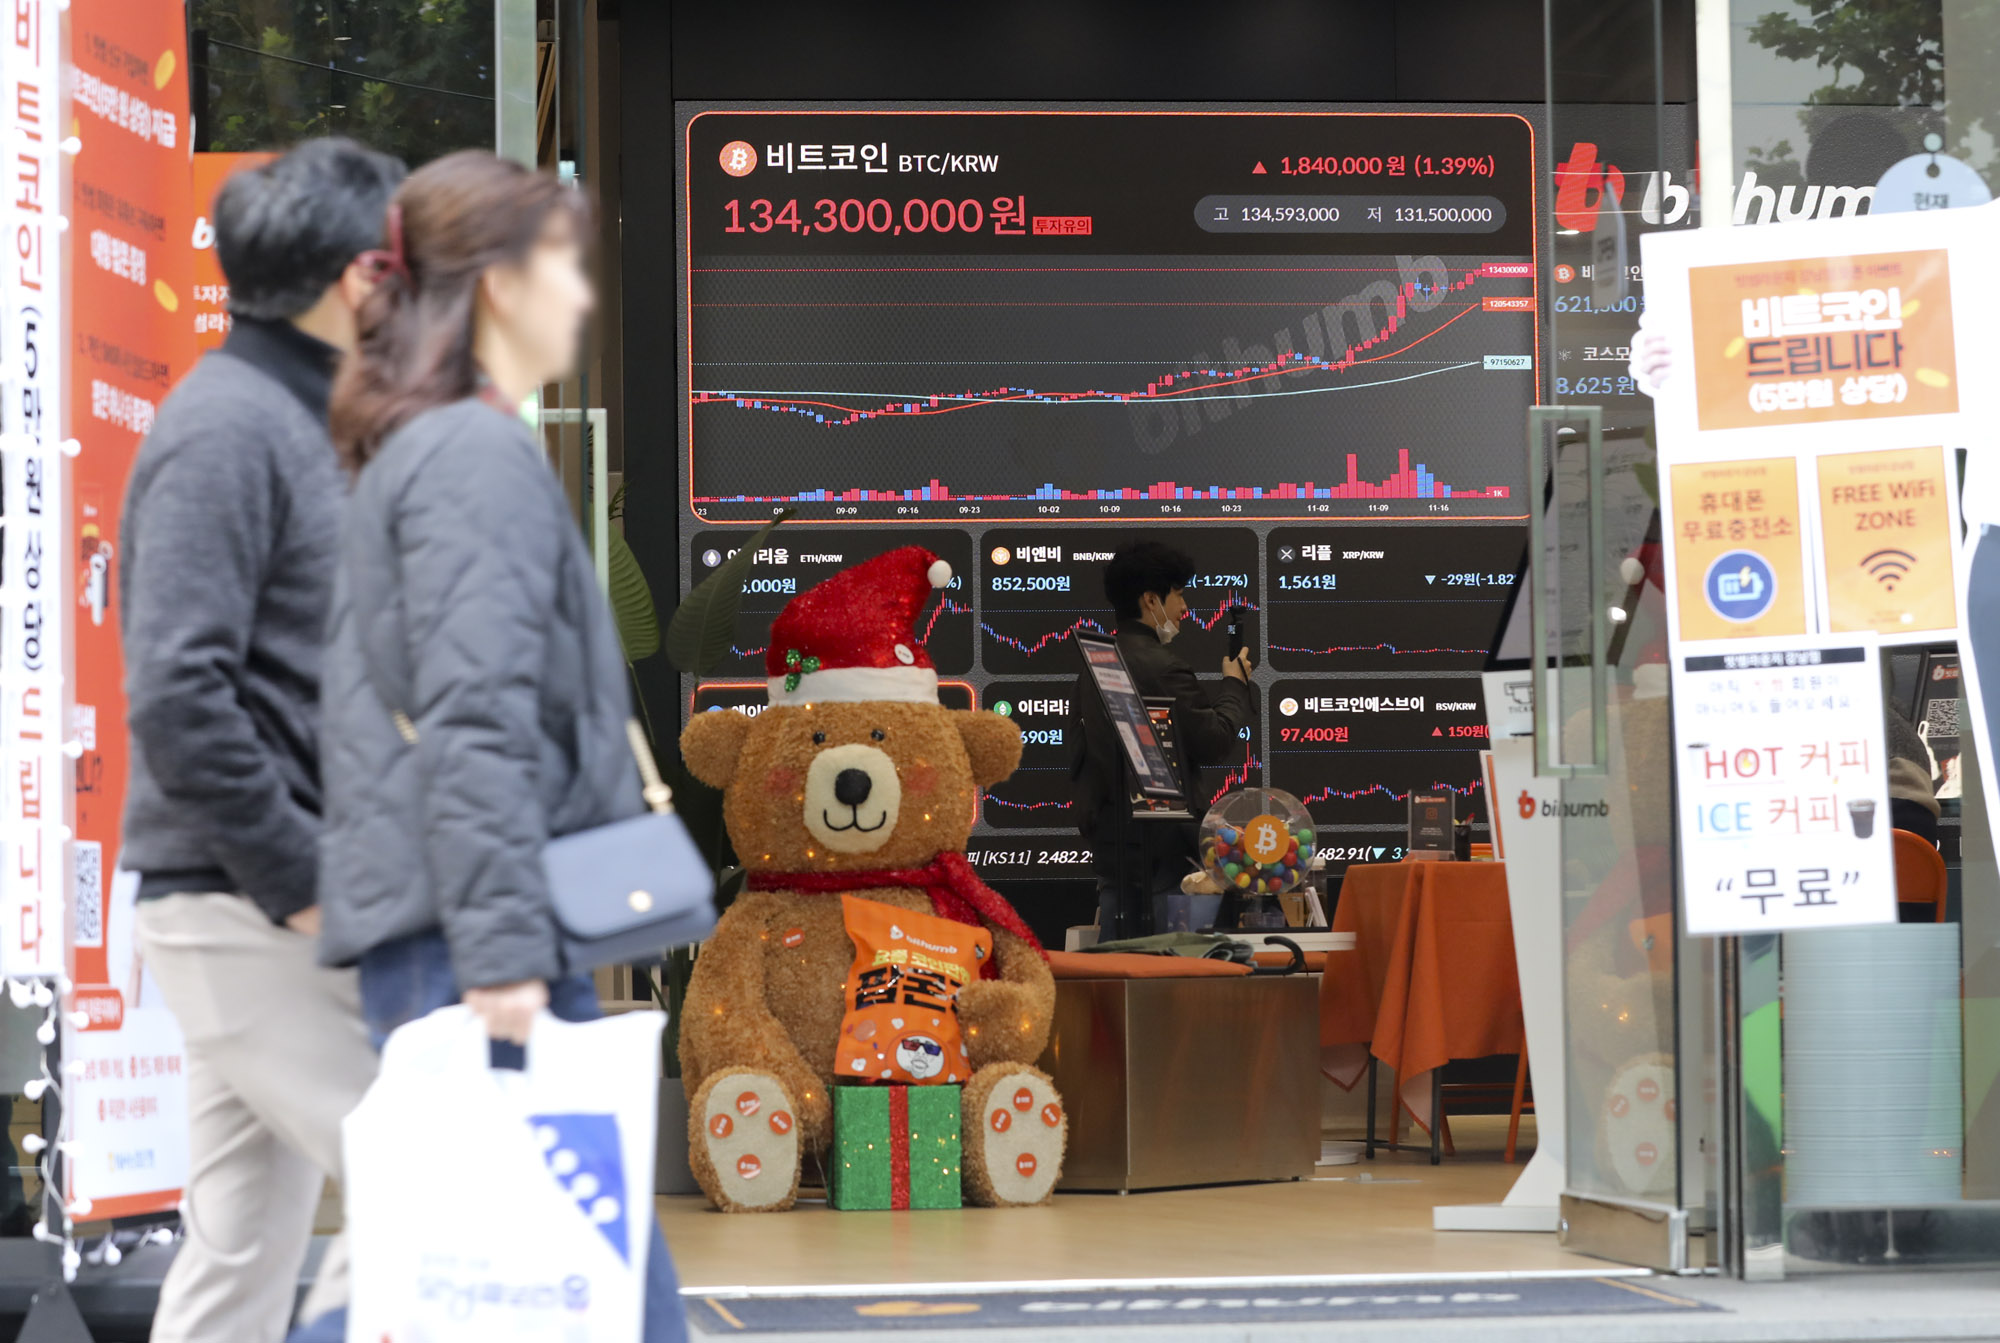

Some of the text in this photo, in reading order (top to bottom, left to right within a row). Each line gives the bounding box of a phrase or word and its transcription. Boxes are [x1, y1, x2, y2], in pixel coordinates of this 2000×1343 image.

[766, 142, 1000, 176] 비트코인 BTC/KRW
[1414, 154, 1496, 179] (1.39%)
[1640, 170, 1878, 226] bhum
[1213, 206, 1493, 224] 고 134,593,000 저 131,500,000
[1034, 217, 1092, 235] 투자유의
[1488, 266, 1528, 274] 134300000
[1582, 264, 1644, 282] 비인
[1740, 287, 1903, 339] 비트코인
[1490, 358, 1526, 366] 97150627
[1746, 330, 1905, 378] 드립니다
[1698, 488, 1765, 515] 휴대폰
[1831, 479, 1936, 506] FREE WiFi
[836, 506, 858, 514] 09-09
[897, 506, 919, 514] 09-16
[959, 506, 981, 514] 09-23
[1038, 505, 1060, 513] 10-02
[1099, 505, 1120, 513] 10-09
[1160, 505, 1182, 513] 10-16
[1221, 505, 1242, 513] 10-23
[1307, 504, 1330, 512] 11-02
[1368, 504, 1389, 512] 11-09
[1428, 504, 1449, 512] 11-16
[1855, 508, 1917, 532] ZONE
[727, 547, 843, 565] 리움 ETH/KRW
[1016, 545, 1062, 563] 비앤비
[1301, 544, 1385, 562] 리플 XRP/KRW
[991, 573, 1249, 592] 852,500원 (-1.27%)
[1278, 572, 1517, 590] 1,561원 -29원(-1.82
[1304, 695, 1477, 713] 비트코인에스브이 BSV/KRW
[1280, 726, 1349, 743] 97,400원
[1704, 738, 1870, 780] HOT 커피
[1697, 793, 1840, 835] ICE 커피
[982, 850, 1032, 866] [KS11]
